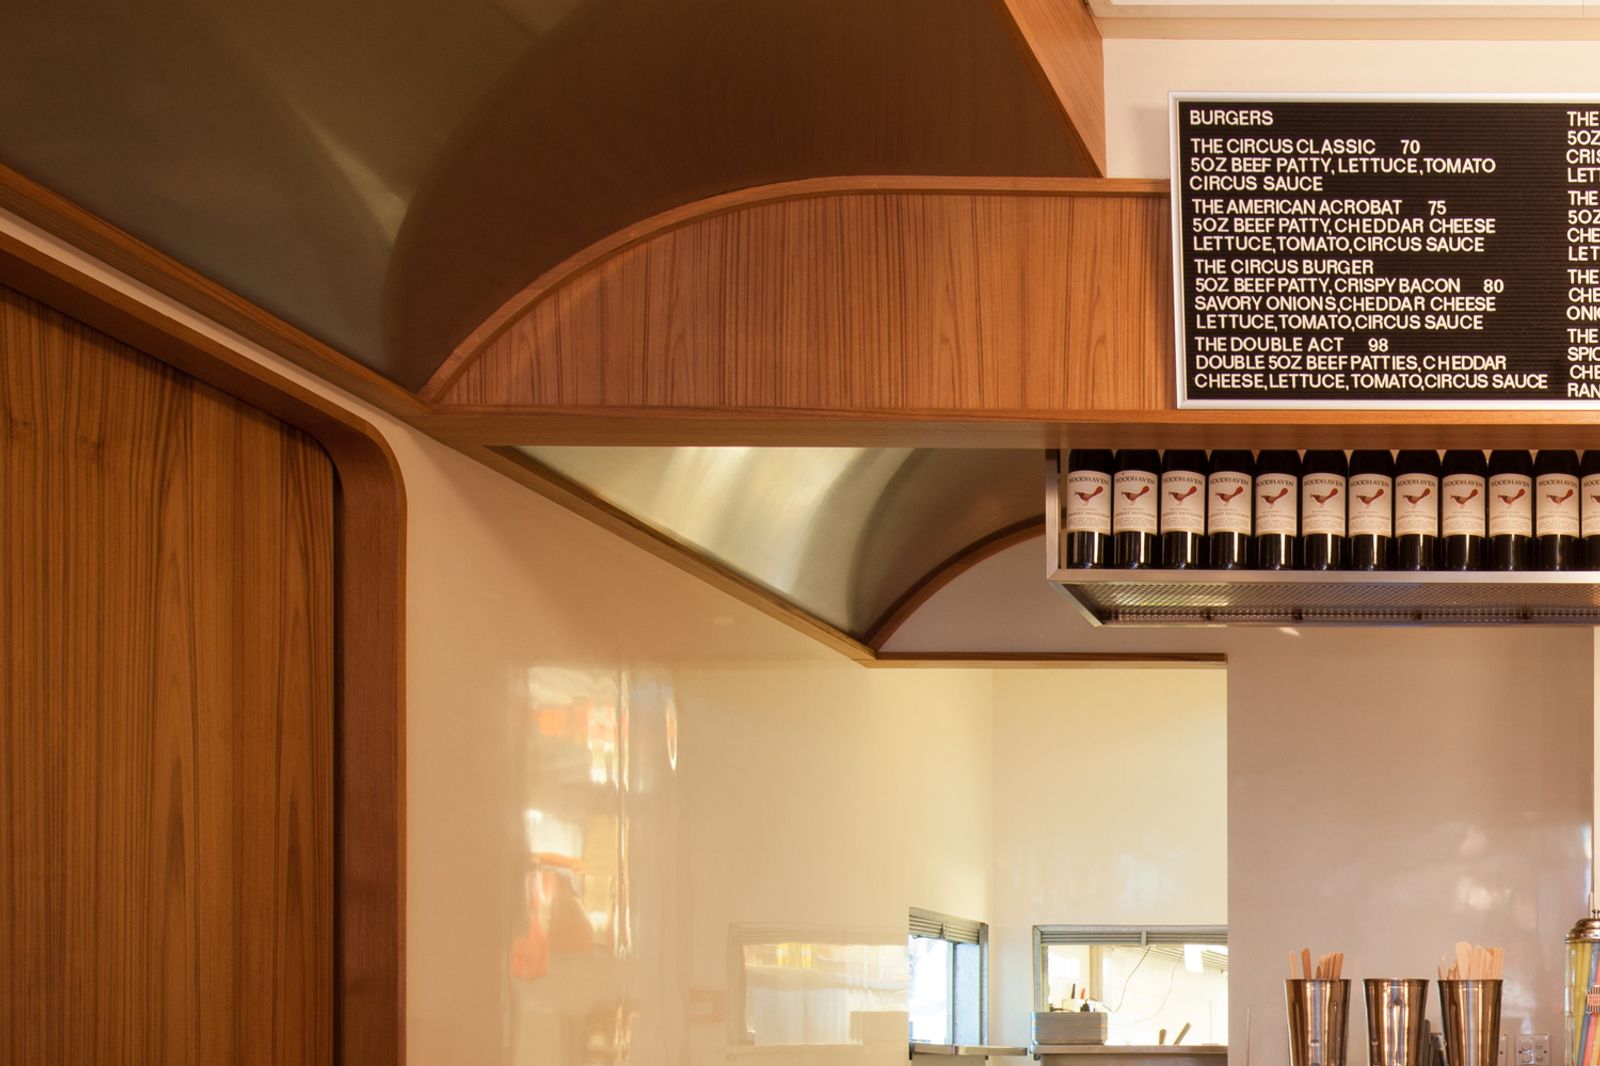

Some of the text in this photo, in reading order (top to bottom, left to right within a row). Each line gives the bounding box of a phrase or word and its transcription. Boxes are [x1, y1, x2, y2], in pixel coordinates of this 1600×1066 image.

[1189, 109, 1274, 126] BURGERS
[1566, 110, 1600, 127] THE
[1190, 138, 1421, 155] THE CIRCUS CLASSIC 70
[1189, 175, 1324, 192] CIRCUS SAUCE
[1567, 189, 1599, 206] THE
[1191, 198, 1447, 216] THE AMERICAN ACROBAT 75
[1193, 258, 1374, 275] THE CIRCUS BURGER
[1566, 268, 1600, 285] THE
[1233, 277, 1276, 293] BEEF
[1334, 277, 1397, 293] CRISPY
[1398, 277, 1461, 294] BACON
[1483, 278, 1505, 294] 80
[1194, 336, 1389, 353] THE DOUBLE ACT 98
[1566, 328, 1599, 345] THE
[1195, 354, 1266, 370] DOUBLE
[1306, 355, 1349, 371] BEEF
[1422, 355, 1507, 372] CHEDDAR
